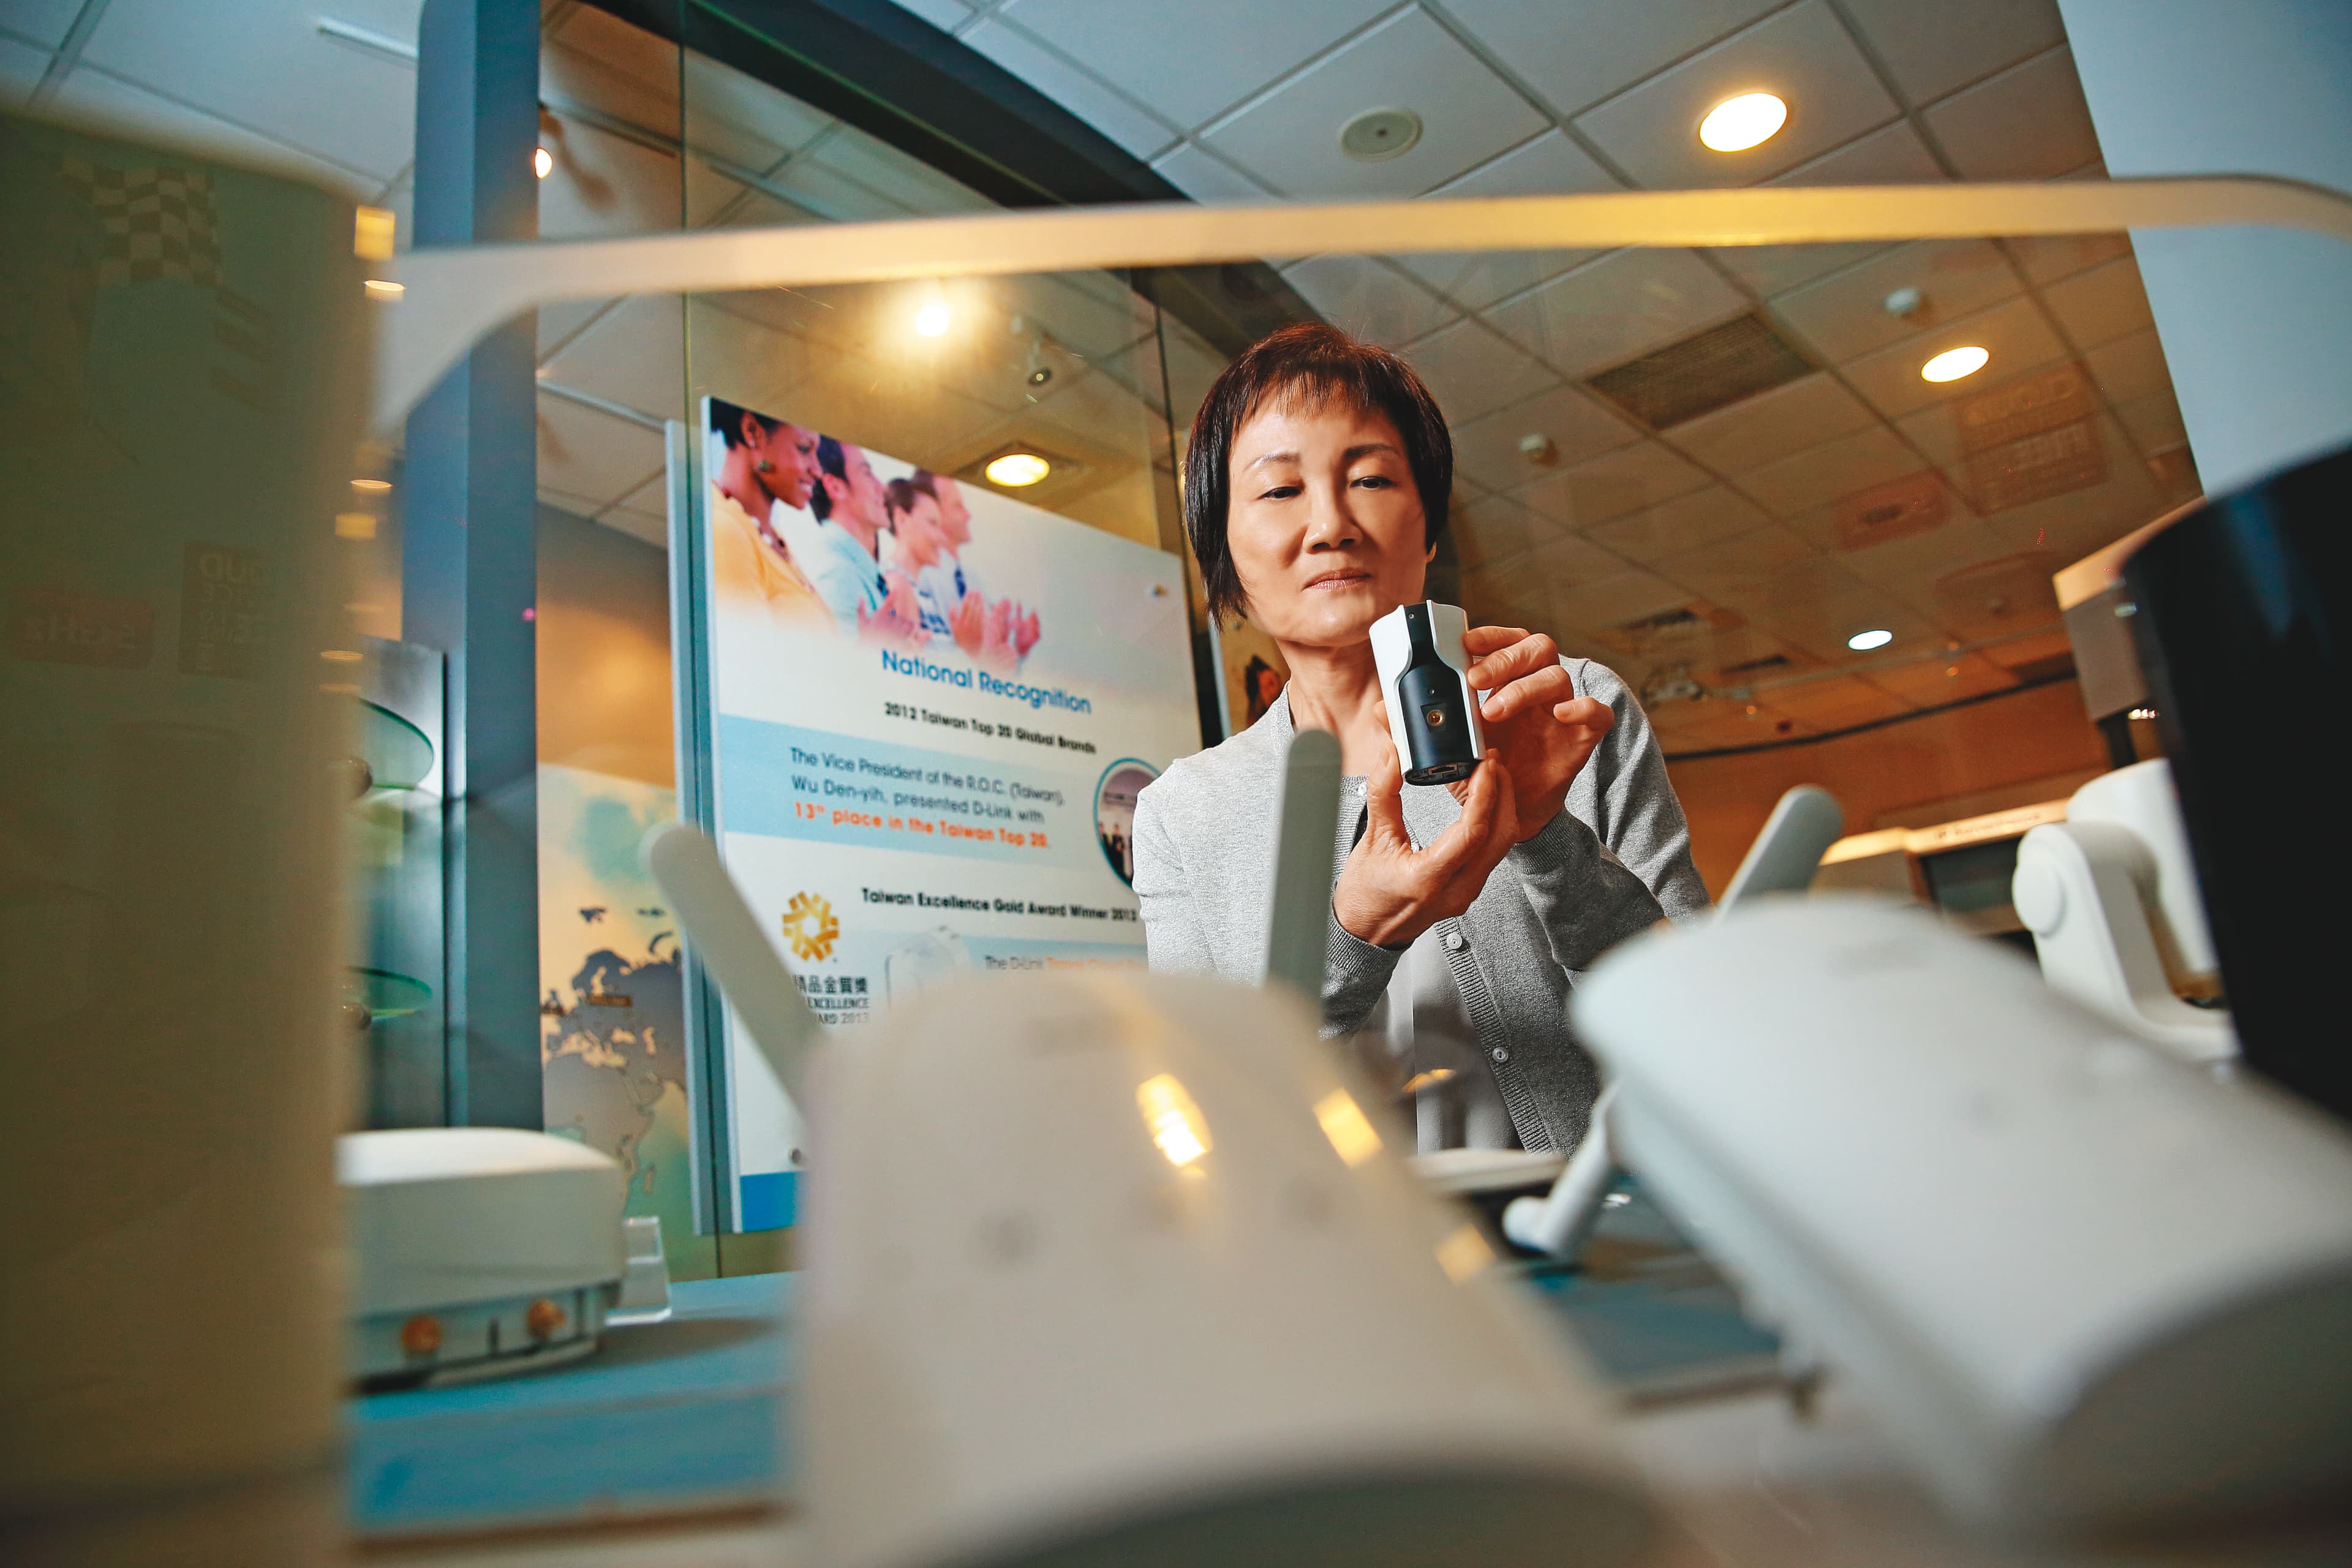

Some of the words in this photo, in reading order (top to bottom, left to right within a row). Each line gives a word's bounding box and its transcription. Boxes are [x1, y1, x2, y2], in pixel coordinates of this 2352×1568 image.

[882, 648, 973, 688] National
[979, 671, 1092, 714] Recognition
[885, 702, 916, 721] 2012
[921, 709, 968, 730] Taiwan
[971, 719, 993, 737] Top
[998, 724, 1012, 738] 20
[1016, 728, 1055, 746] Global
[1058, 736, 1096, 754] Brands
[791, 747, 819, 766] The
[821, 752, 856, 772] Vice
[859, 758, 922, 782] President
[925, 771, 940, 785] of
[942, 772, 963, 789] the
[791, 775, 819, 794] Wu
[894, 793, 969, 814] presented
[973, 800, 1012, 819] D-Link
[1018, 809, 1045, 824] with
[832, 809, 882, 827] place
[889, 814, 903, 831] in
[908, 816, 933, 834] the
[940, 820, 995, 842] Taiwan
[998, 827, 1026, 846] Top
[861, 887, 914, 905] Taiwan
[917, 892, 990, 911] Excellence
[993, 898, 1024, 913] Gold
[1028, 902, 1066, 918] Award
[1069, 903, 1107, 919] Winner
[986, 955, 1008, 970] The
